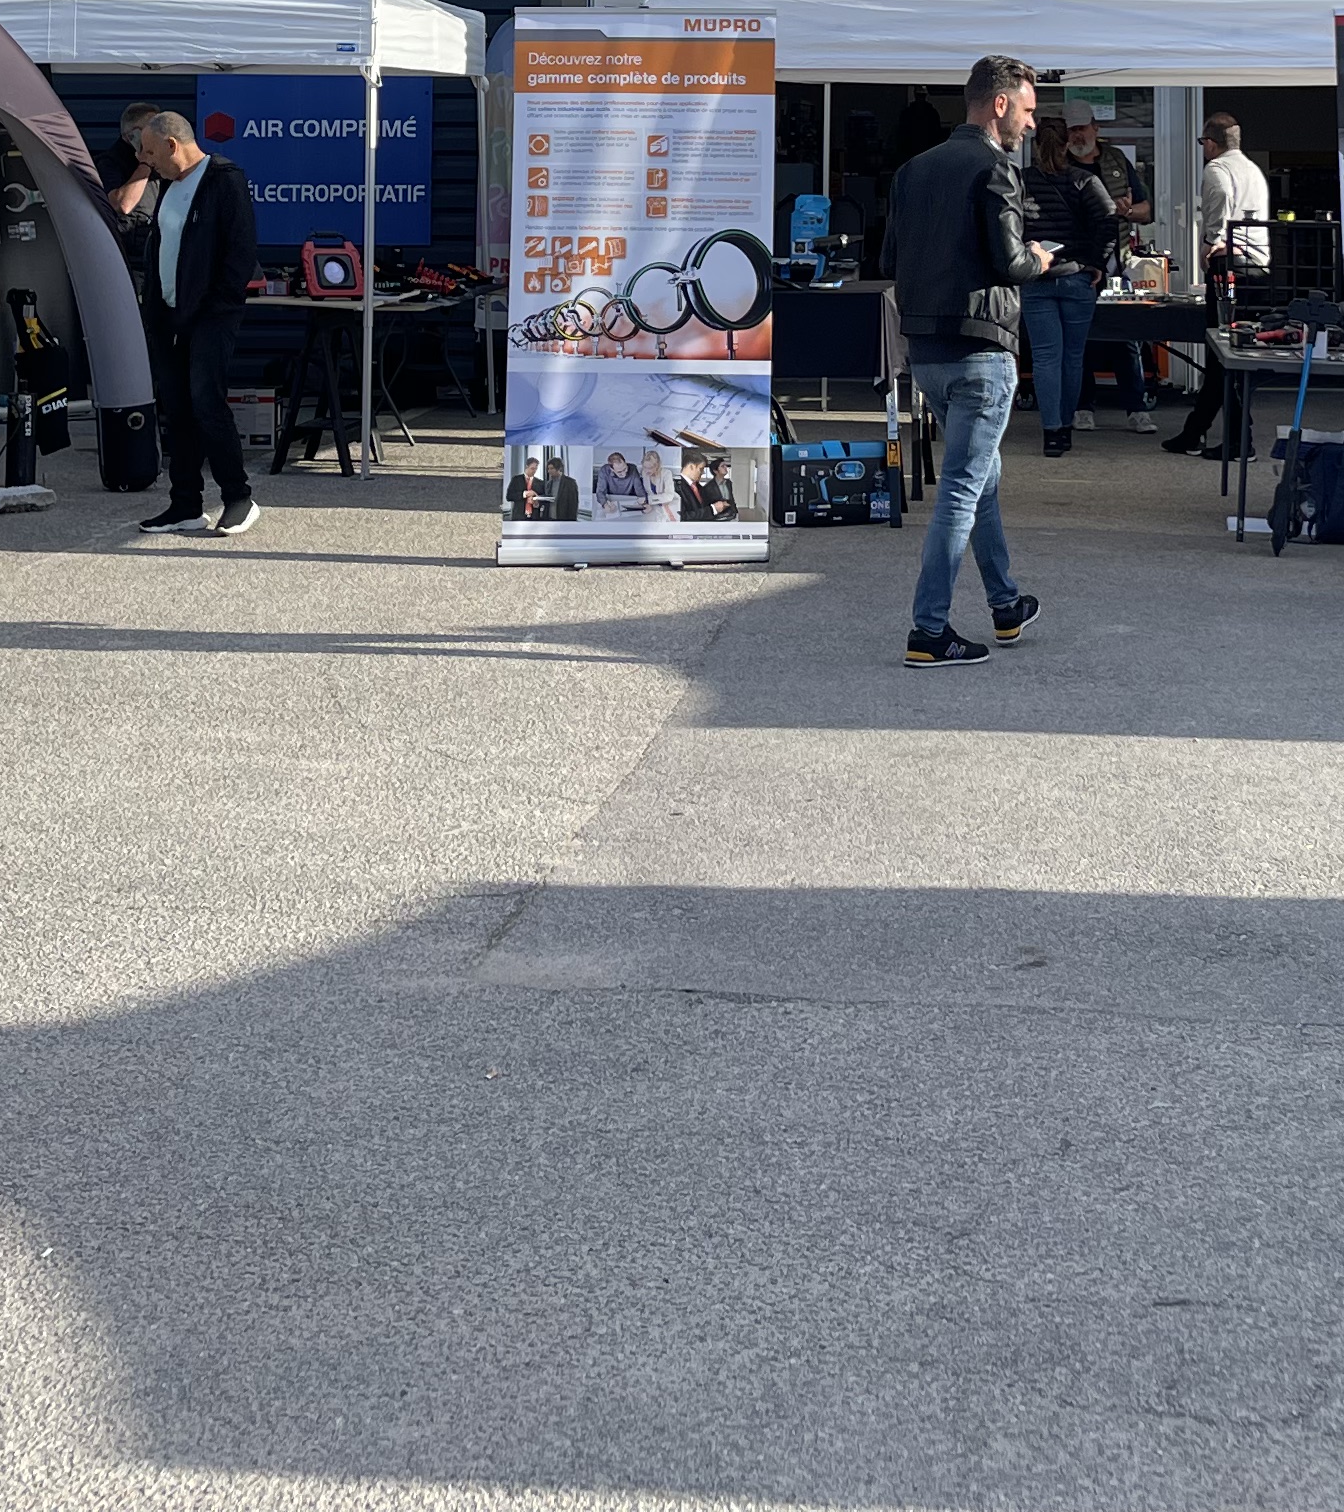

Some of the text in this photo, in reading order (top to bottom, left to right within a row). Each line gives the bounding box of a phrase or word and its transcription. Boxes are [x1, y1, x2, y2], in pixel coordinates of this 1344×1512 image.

[528, 52, 643, 66] Découvrez notre
[527, 70, 747, 87] gamme complète de produits
[242, 119, 284, 138] AIR
